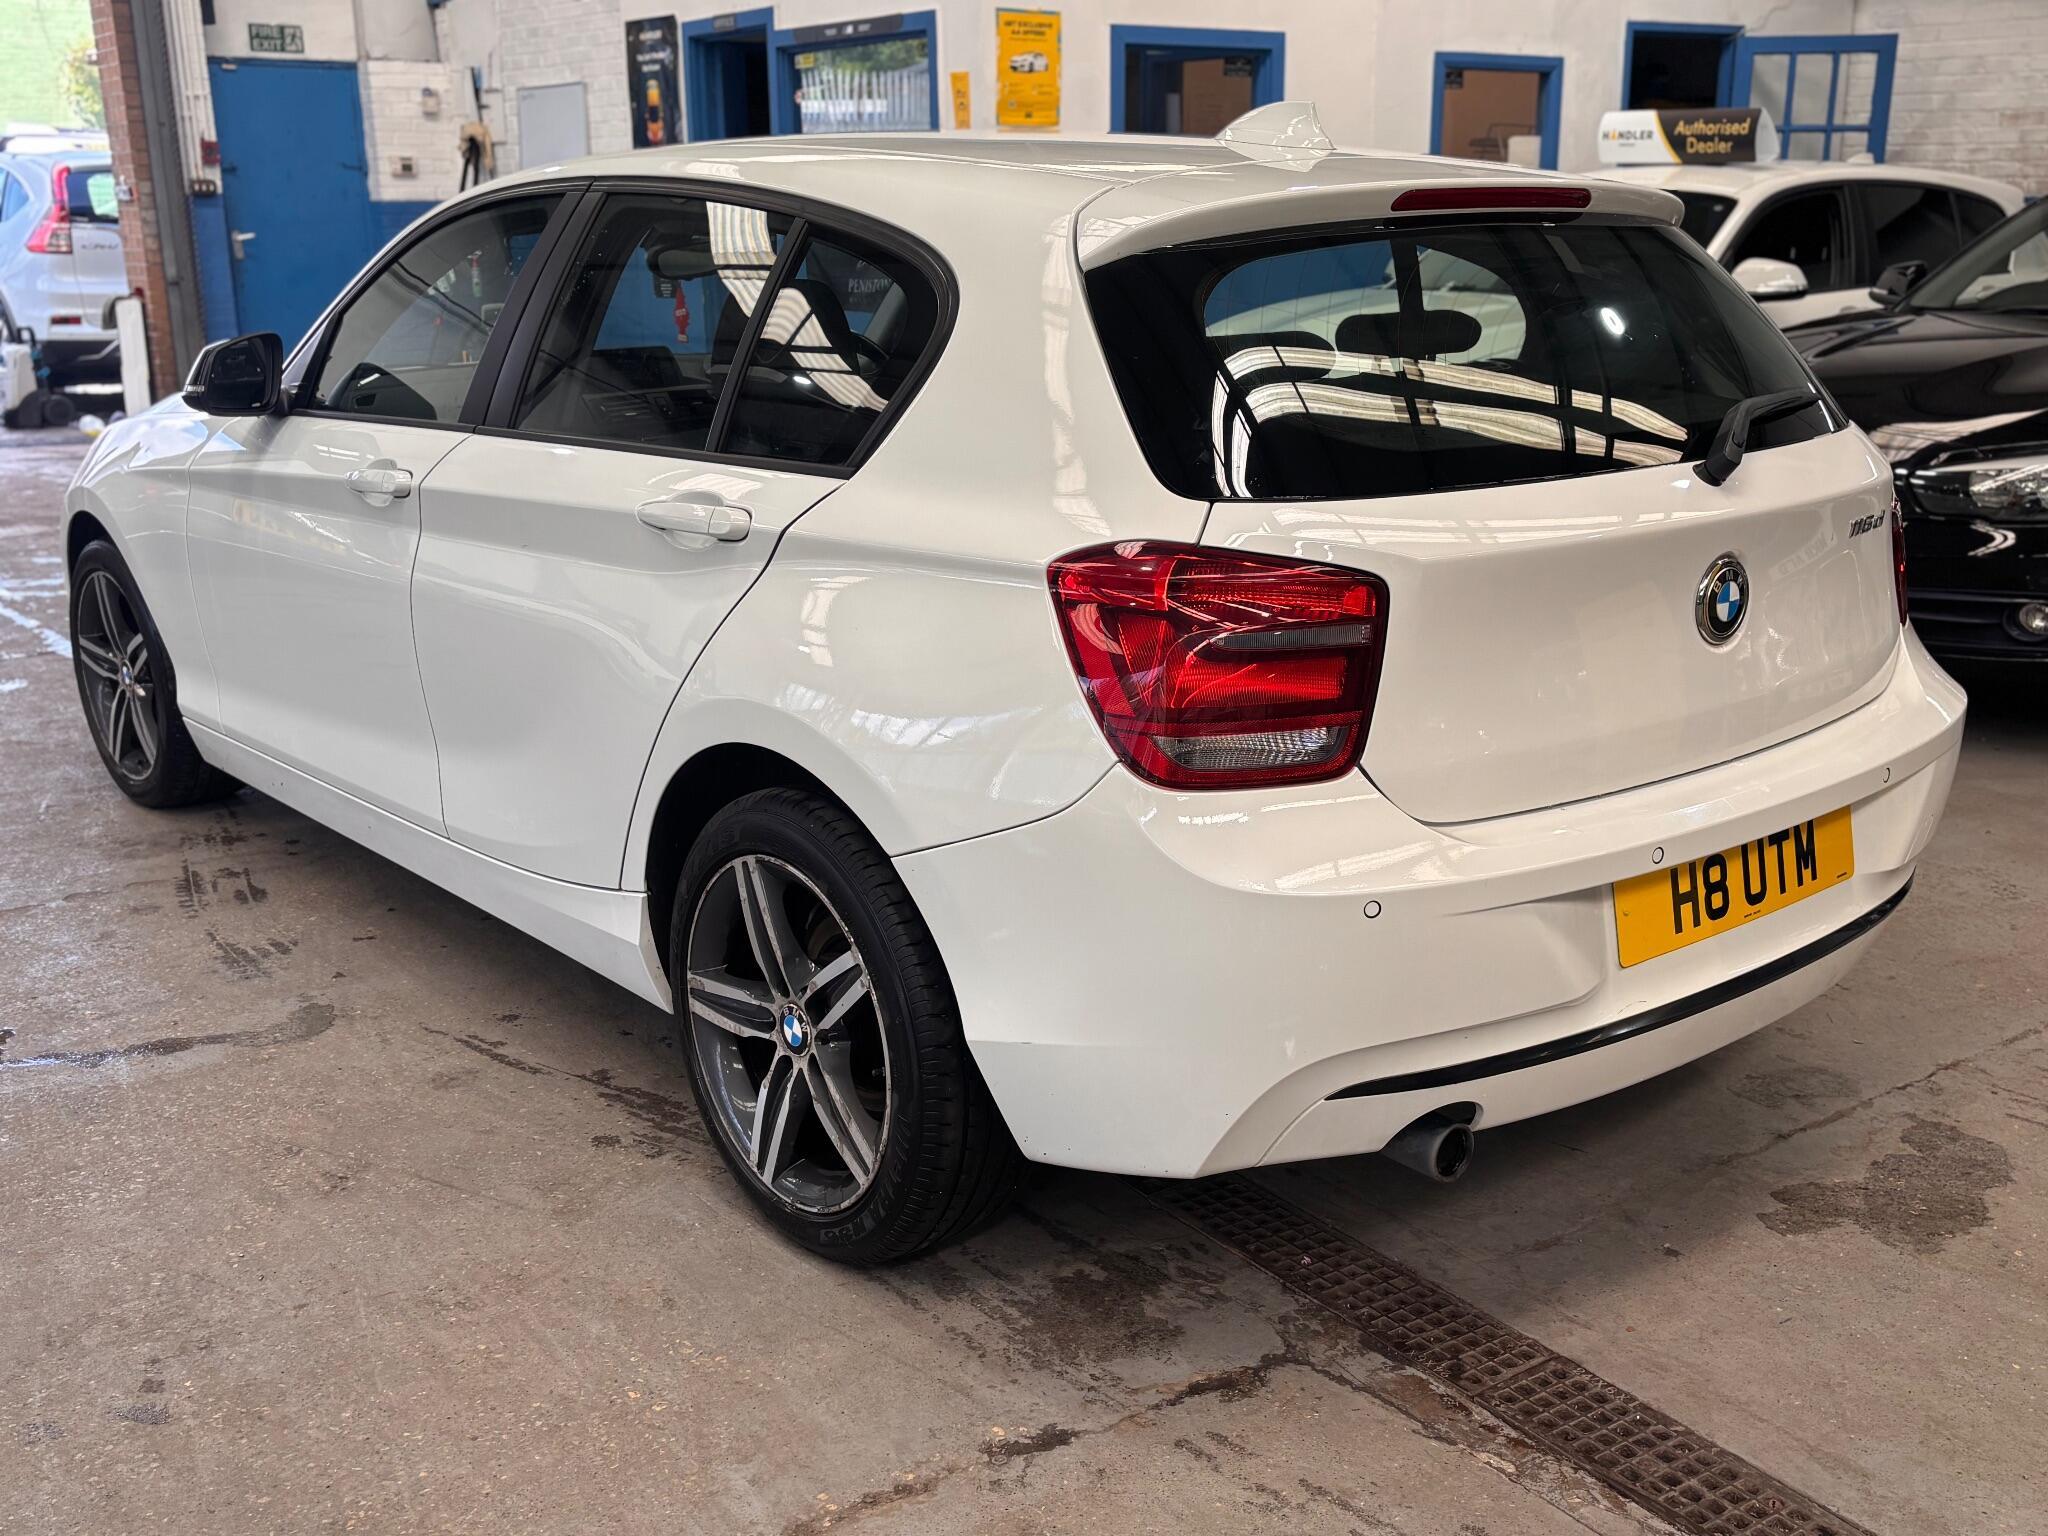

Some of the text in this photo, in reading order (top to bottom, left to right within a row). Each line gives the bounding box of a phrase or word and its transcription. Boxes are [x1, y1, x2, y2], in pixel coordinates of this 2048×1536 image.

[251, 26, 281, 38] FIRE
[252, 38, 282, 52] EXIT
[1673, 118, 1751, 136] Authorised
[1685, 136, 1734, 154] Dealer
[1669, 818, 1819, 936] H8 UTM
